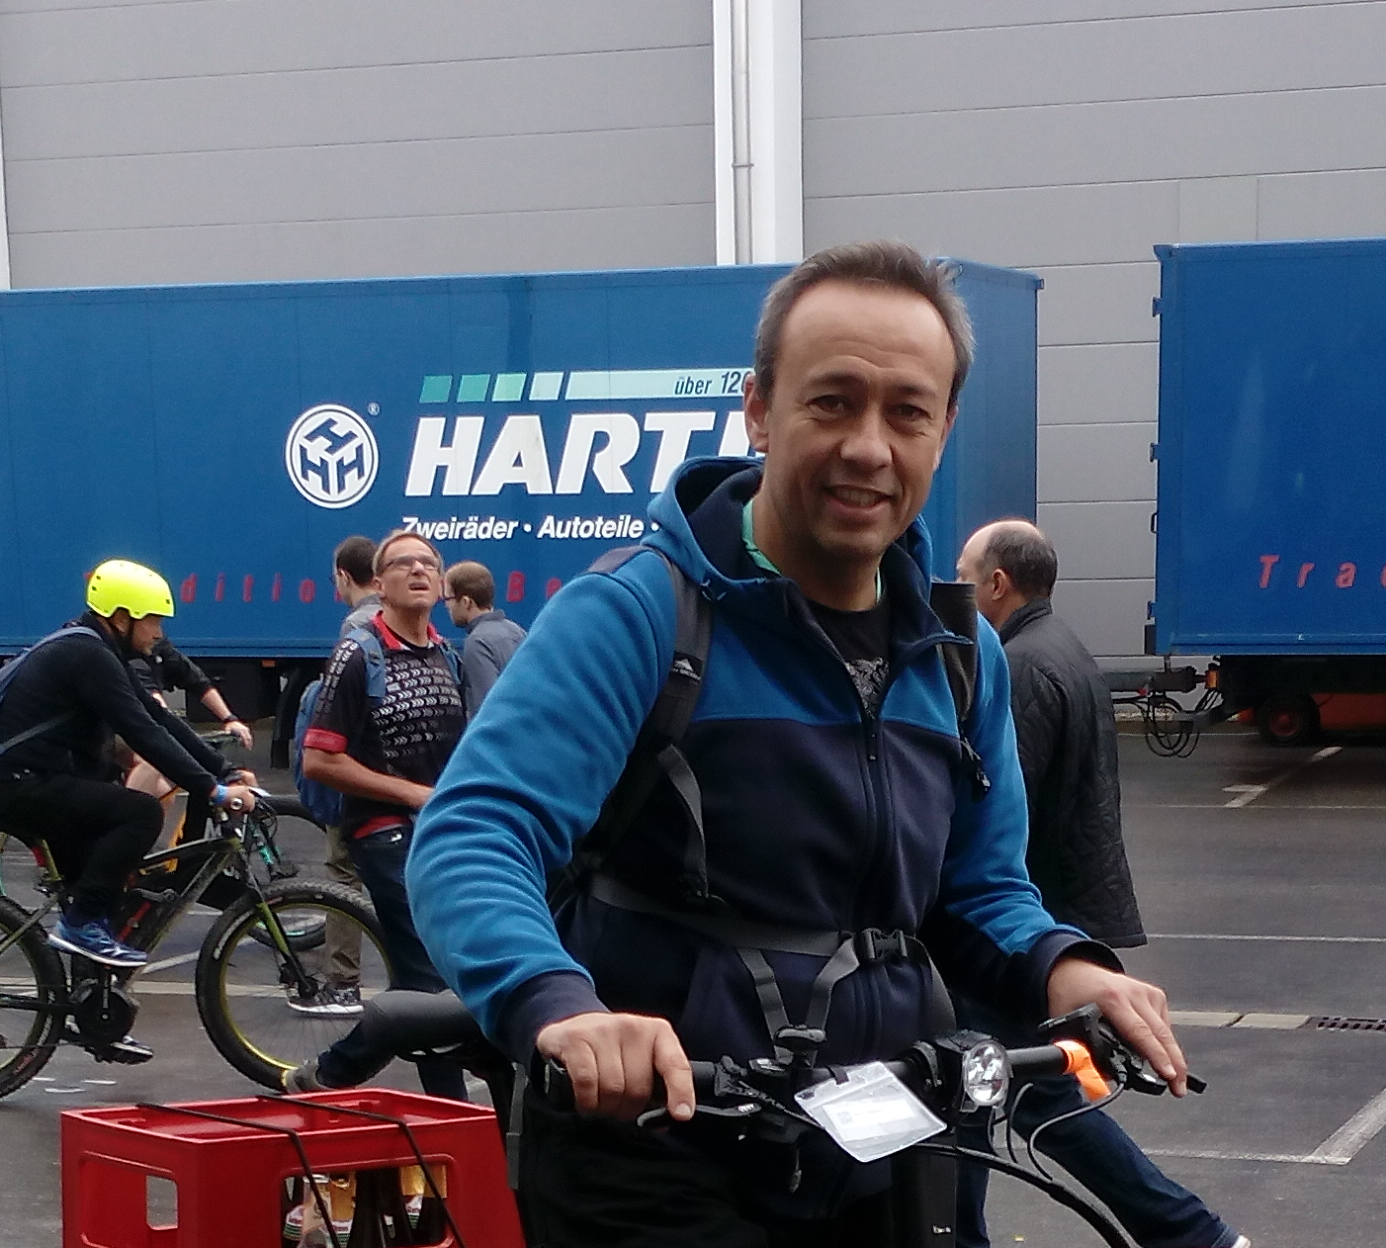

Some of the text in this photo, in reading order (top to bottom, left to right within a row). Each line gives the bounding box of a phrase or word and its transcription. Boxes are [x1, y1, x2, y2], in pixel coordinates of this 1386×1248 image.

[674, 370, 751, 396] über 12
[404, 411, 766, 496] HART
[536, 515, 644, 539] Autoteile
